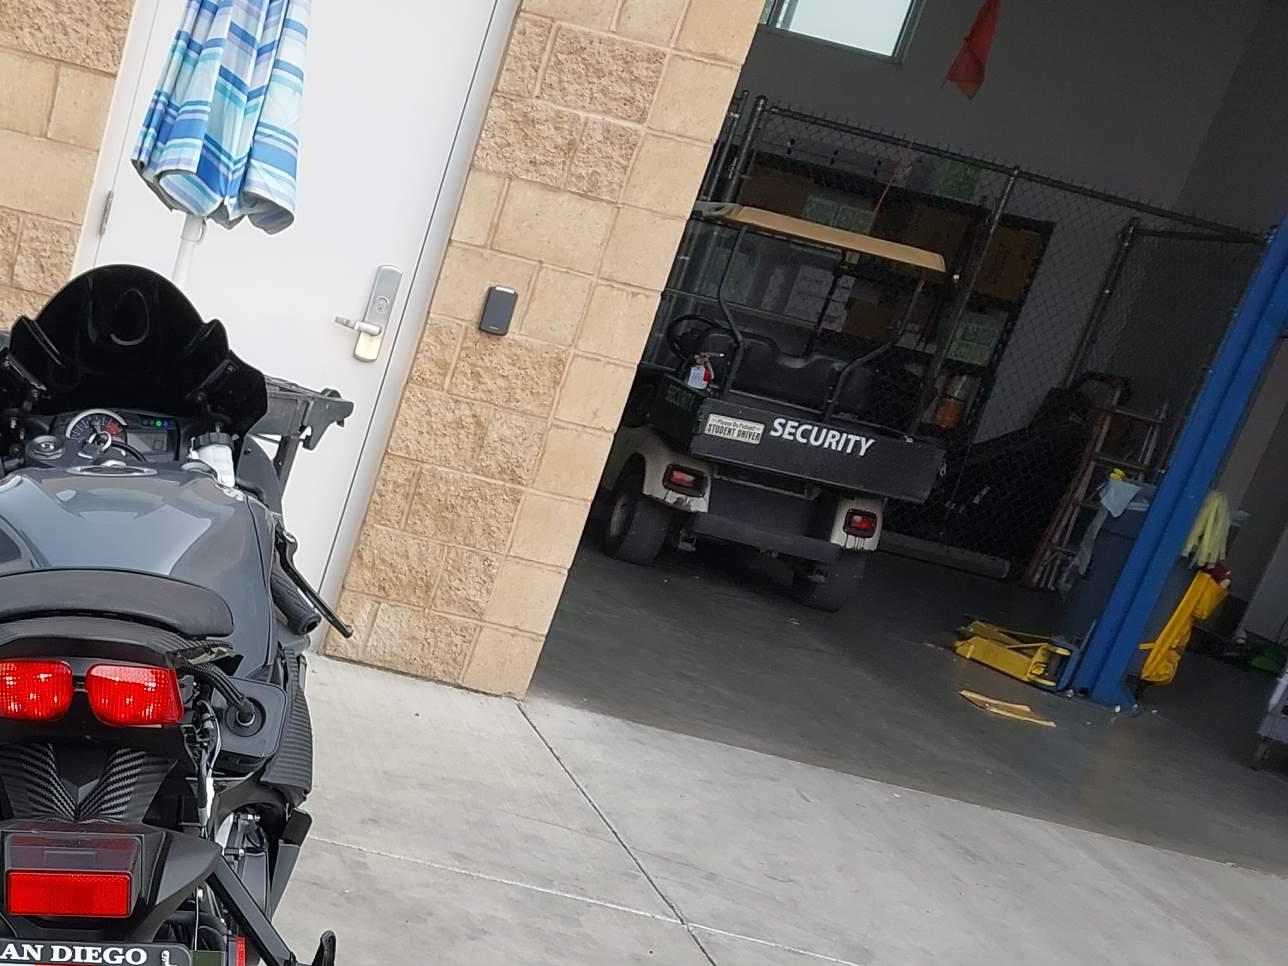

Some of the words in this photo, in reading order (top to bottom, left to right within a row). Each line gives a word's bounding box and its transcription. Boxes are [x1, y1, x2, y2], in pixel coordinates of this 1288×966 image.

[708, 423, 736, 437] STUDENT
[736, 429, 761, 441] DRIVER
[770, 418, 875, 457] SECURITY
[50, 945, 147, 966] DIEGO
